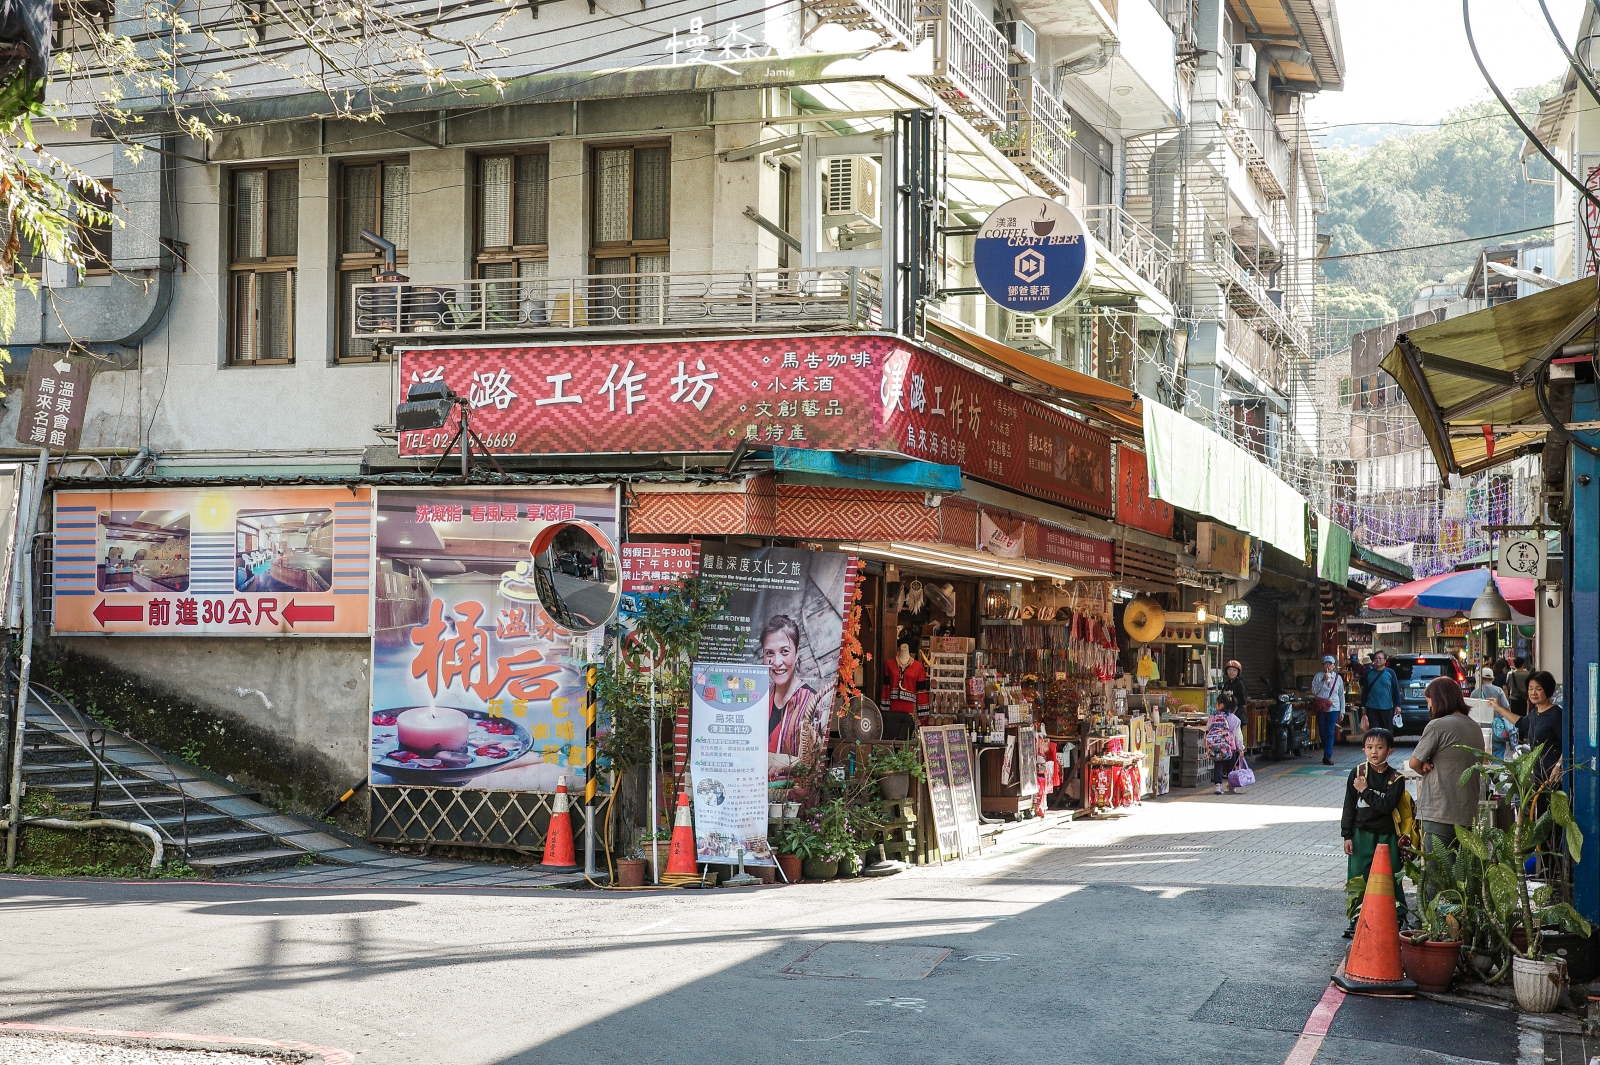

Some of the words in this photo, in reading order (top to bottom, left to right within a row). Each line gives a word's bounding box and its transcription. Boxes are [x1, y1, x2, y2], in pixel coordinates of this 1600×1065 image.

[984, 227, 1028, 239] COFFEE
[1007, 236, 1048, 247] CRAFT
[1048, 234, 1079, 246] BEER
[781, 351, 872, 370] 馬告咖啡
[767, 376, 835, 393] 小米酒
[29, 377, 56, 443] 烏來名湯
[49, 381, 75, 447] 溫泉會館
[754, 399, 844, 418] 文創藝品
[744, 424, 808, 441] 農特產
[906, 424, 967, 466] 烏來海角8號
[415, 504, 463, 523] 洗凝脂
[470, 504, 518, 522] 看風景
[622, 547, 691, 558] 例假日上午9:00
[702, 554, 802, 576] 體驗深度文化之旅
[148, 598, 279, 625] 前進30公尺
[715, 713, 745, 724] 烏來區
